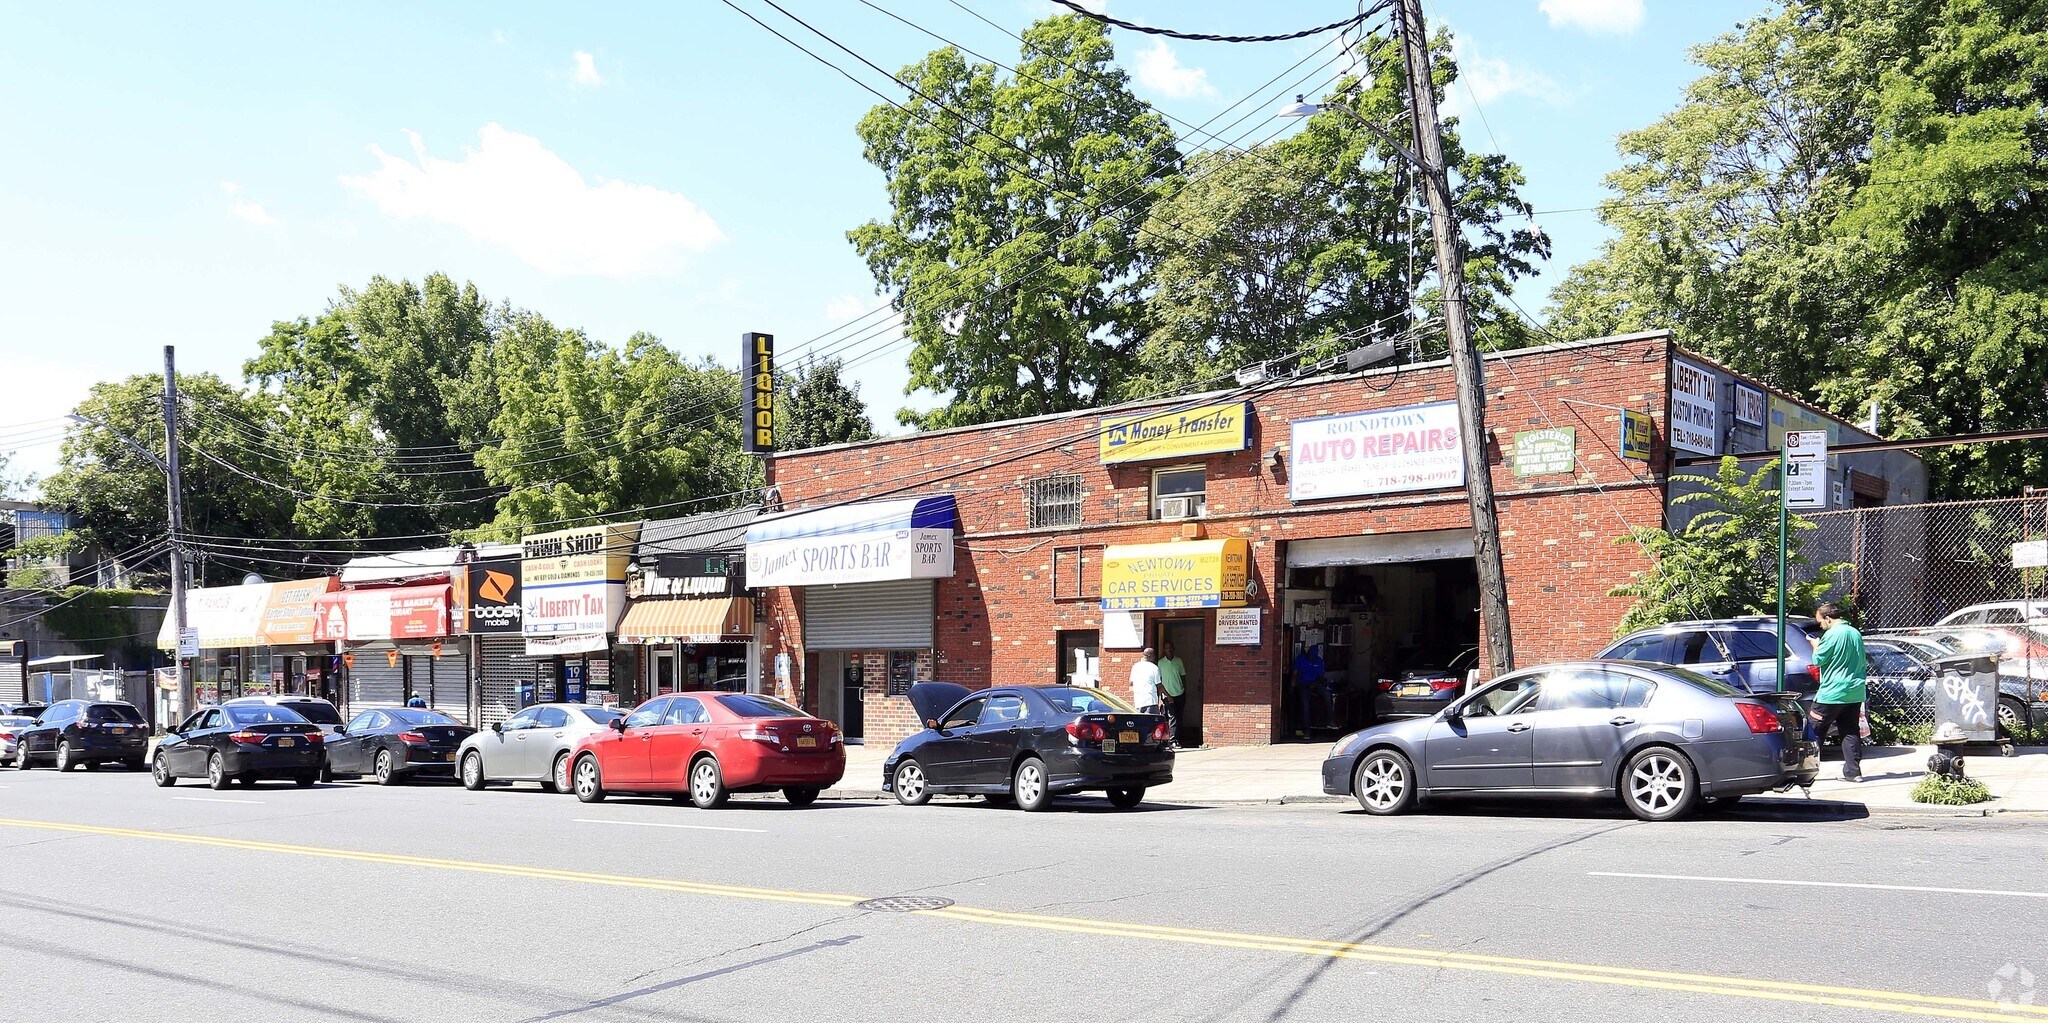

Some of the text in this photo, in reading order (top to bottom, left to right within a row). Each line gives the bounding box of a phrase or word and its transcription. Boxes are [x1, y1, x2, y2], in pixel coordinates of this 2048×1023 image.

[756, 336, 773, 446] LIQUOR
[1673, 363, 1715, 402] LIBERTY TAX
[1673, 398, 1714, 430] CUSTOM PRINTING
[1130, 422, 1173, 441] Money
[1178, 411, 1235, 434] Transfer
[1327, 412, 1427, 435] ROUNDTOWN
[1298, 427, 1459, 464] AUTO REPAIRS
[1517, 430, 1572, 449] REGISTERED
[1517, 451, 1573, 465] MOTOR VEHICLE
[1520, 461, 1569, 474] REPAIR SHOP
[1789, 462, 1796, 475] 2
[1378, 469, 1458, 487] 718-798-0907
[525, 537, 562, 558] PAWN
[915, 542, 943, 554] SPORTS
[525, 564, 538, 572] CASH
[574, 560, 587, 568] CASH
[802, 544, 857, 573] SPORTS
[860, 542, 891, 569] BAR
[921, 553, 937, 565] BAR
[1128, 557, 1197, 574] NEWTOWN
[644, 570, 671, 596] WINE
[1108, 577, 1214, 595] CAR SERVICES
[475, 602, 521, 620] boost
[539, 593, 604, 618] LIBERTY TAX
[485, 618, 510, 627] mobile
[568, 666, 581, 678] 19
